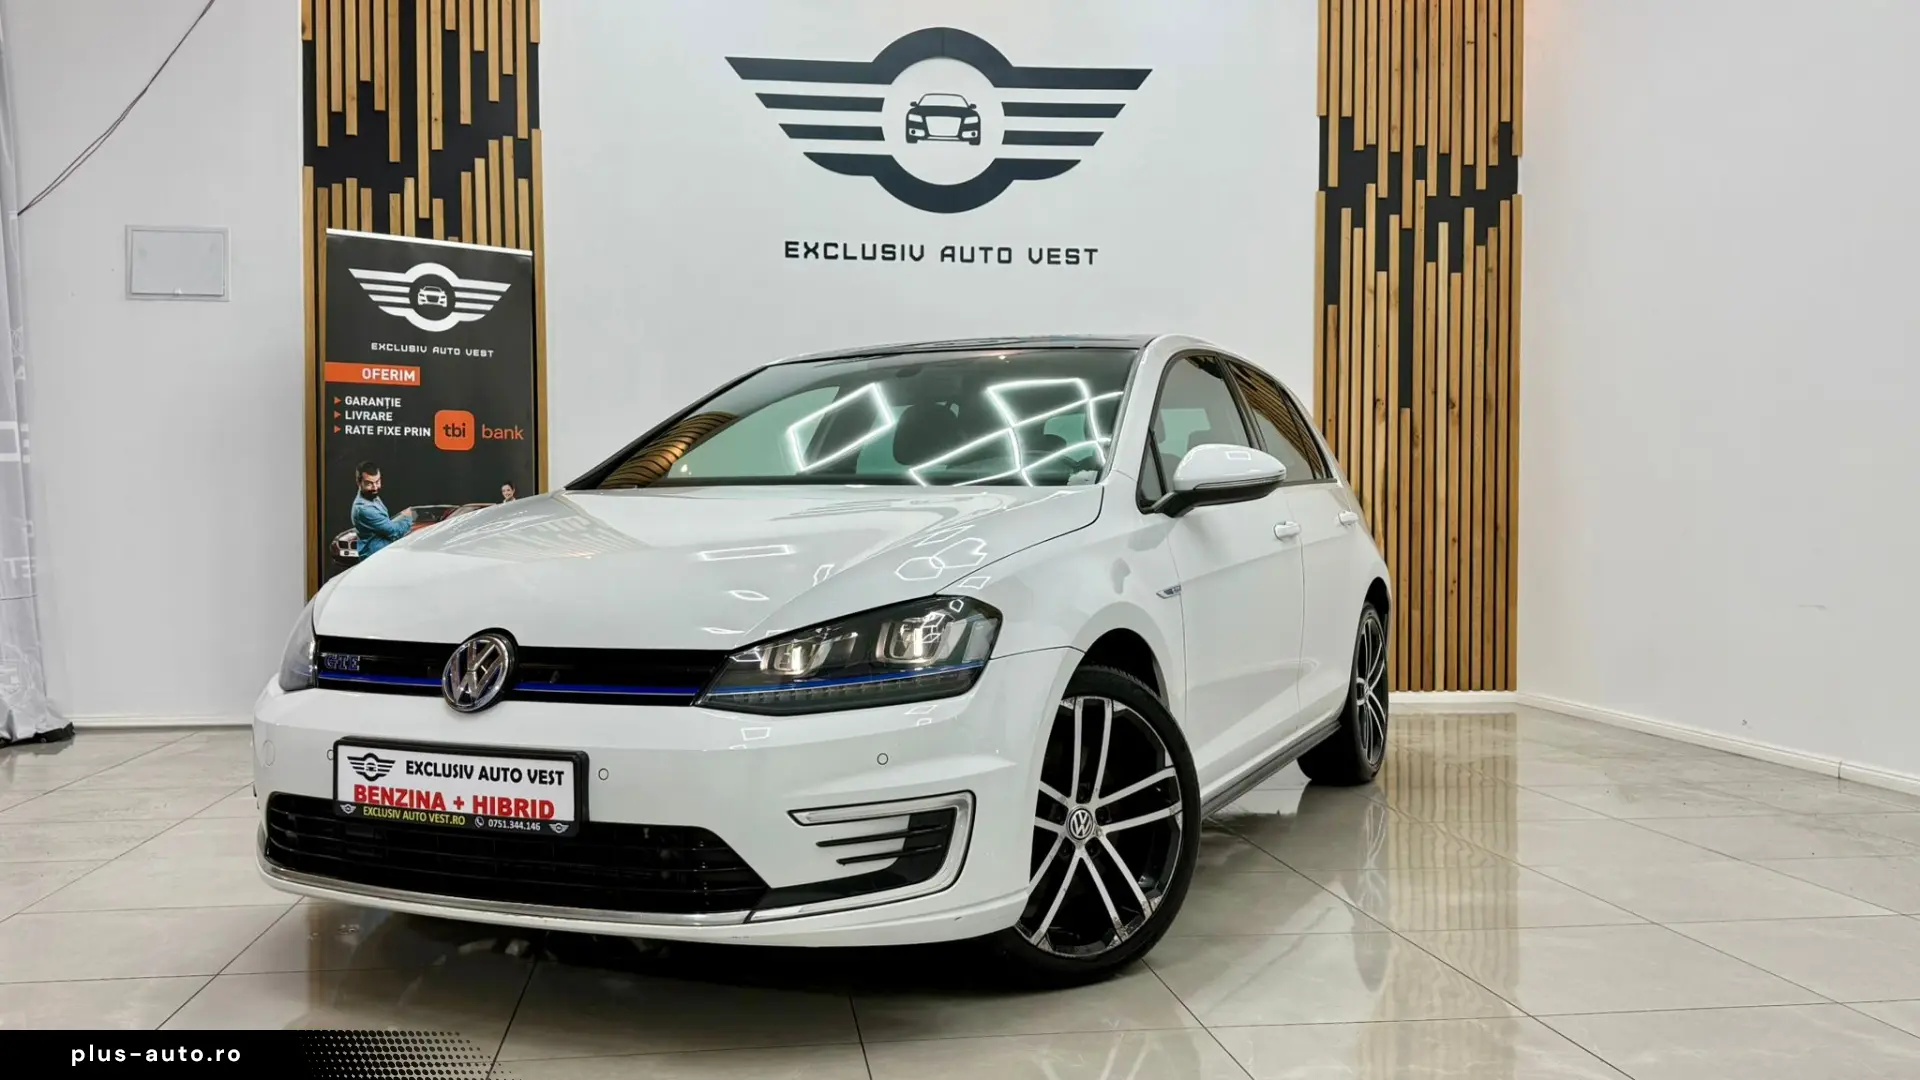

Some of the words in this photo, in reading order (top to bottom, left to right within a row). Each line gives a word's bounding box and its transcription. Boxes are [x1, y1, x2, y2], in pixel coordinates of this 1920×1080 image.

[784, 240, 925, 262] EXCLUSIV
[940, 245, 1012, 264] AUTO
[1028, 247, 1099, 265] VEST
[371, 342, 428, 354] EXCLUSIV
[432, 346, 461, 356] AUTO
[465, 348, 494, 358] VEST
[361, 367, 416, 382] OFERIM
[345, 411, 393, 422] LIVRARE
[345, 425, 374, 436] RATE
[377, 426, 401, 437] FIXE
[404, 426, 431, 437] PRIN
[443, 422, 466, 438] tbi
[481, 425, 524, 440] bank
[324, 654, 361, 672] GTE
[405, 760, 475, 780] EXCLUSIV
[478, 765, 523, 784] AUTO
[527, 769, 565, 787] VEST
[353, 784, 447, 811] BENZINA
[472, 795, 555, 820] HIBRID
[363, 806, 402, 820] EXCLUSIV
[402, 809, 428, 823] AUTO
[429, 813, 466, 826] VEST.RO
[488, 819, 541, 832] 0751.344.146
